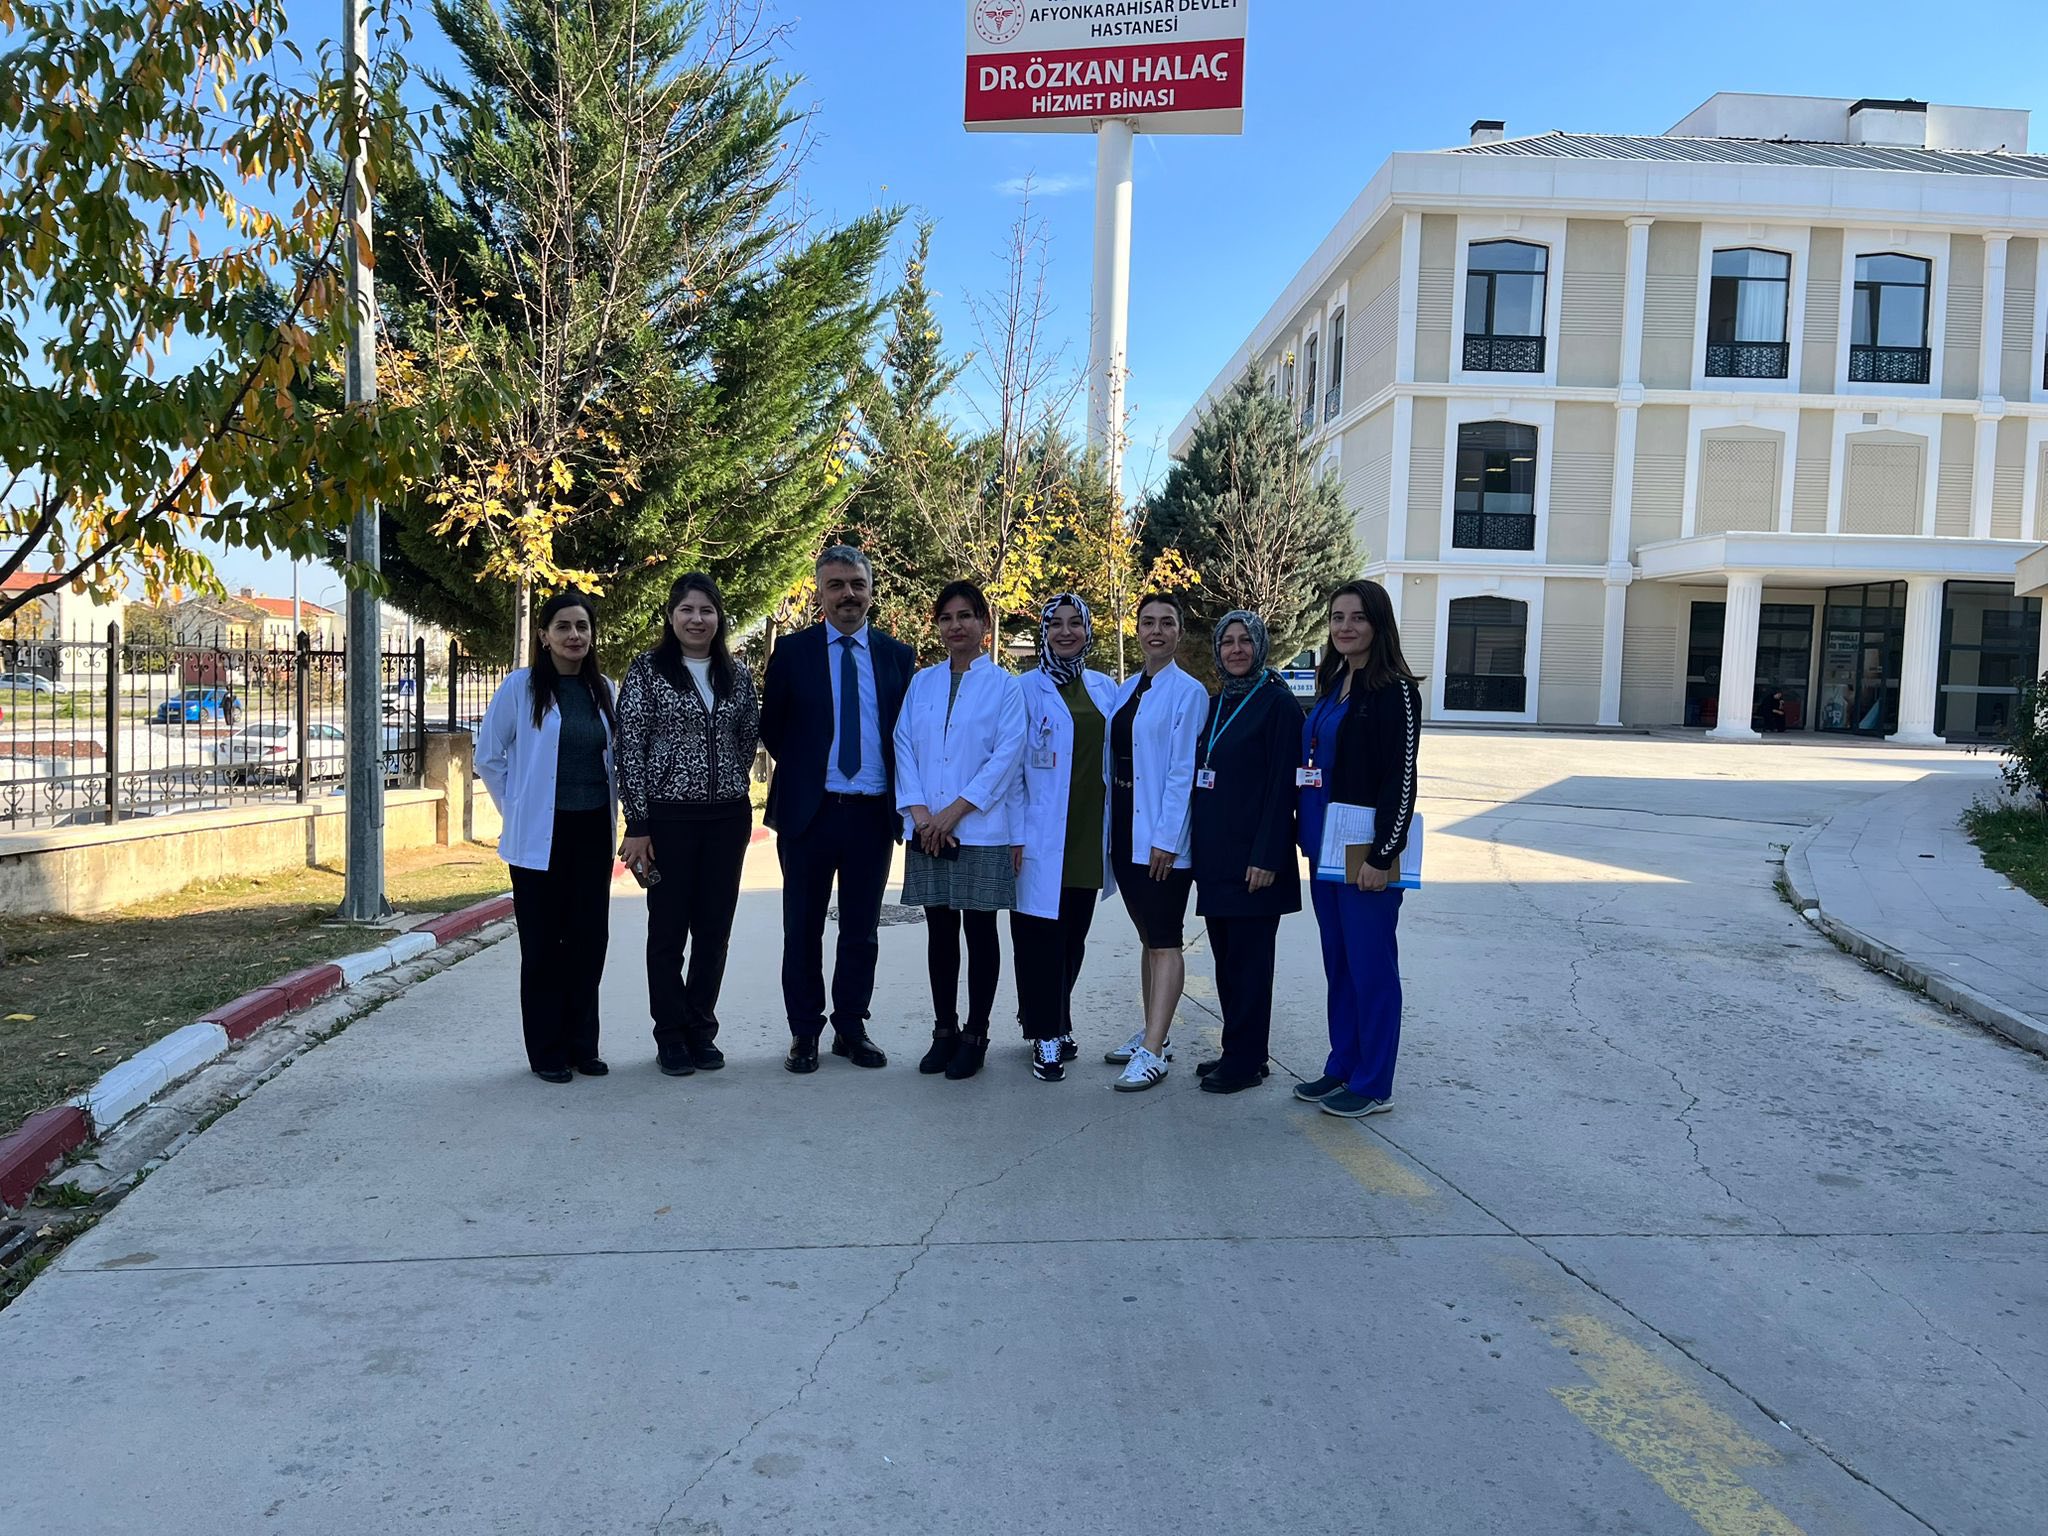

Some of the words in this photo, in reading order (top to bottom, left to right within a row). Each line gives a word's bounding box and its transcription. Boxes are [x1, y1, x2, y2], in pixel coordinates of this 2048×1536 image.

[1091, 15, 1178, 37] HASTANESİ
[980, 57, 1124, 91] DR.ÖZKAN
[1132, 53, 1228, 82] HALAÇ
[1032, 92, 1106, 113] HİZMET
[1110, 88, 1175, 109] BİNASI
